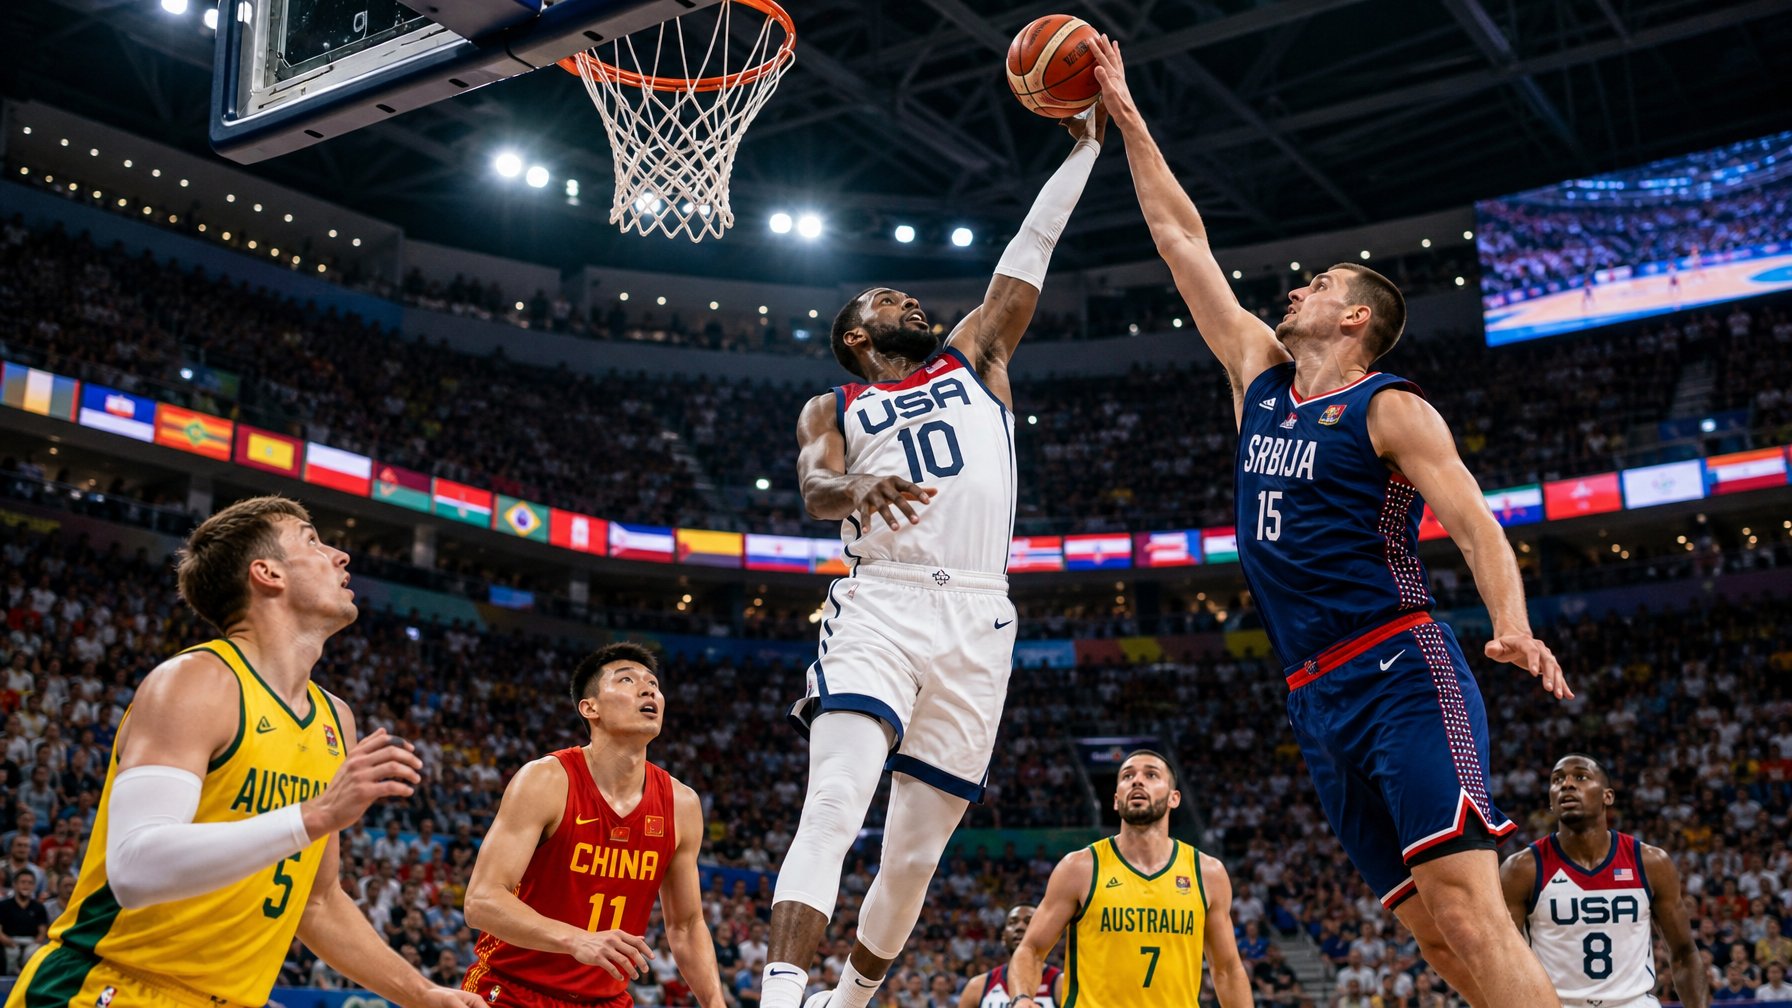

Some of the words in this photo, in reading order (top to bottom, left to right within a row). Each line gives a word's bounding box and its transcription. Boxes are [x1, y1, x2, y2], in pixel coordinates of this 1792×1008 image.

[857, 377, 971, 435] USA
[897, 420, 964, 483] 10
[1244, 434, 1317, 480] SRBIJA
[1256, 490, 1283, 542] 15
[230, 767, 327, 815] AUSTRA
[570, 842, 659, 880] CHINA
[262, 851, 302, 919] 5
[587, 892, 627, 934] 11
[1100, 907, 1194, 935] AUSTRALIA
[1550, 895, 1638, 926] USA
[1140, 946, 1160, 988] 7
[1582, 932, 1613, 980] 8
